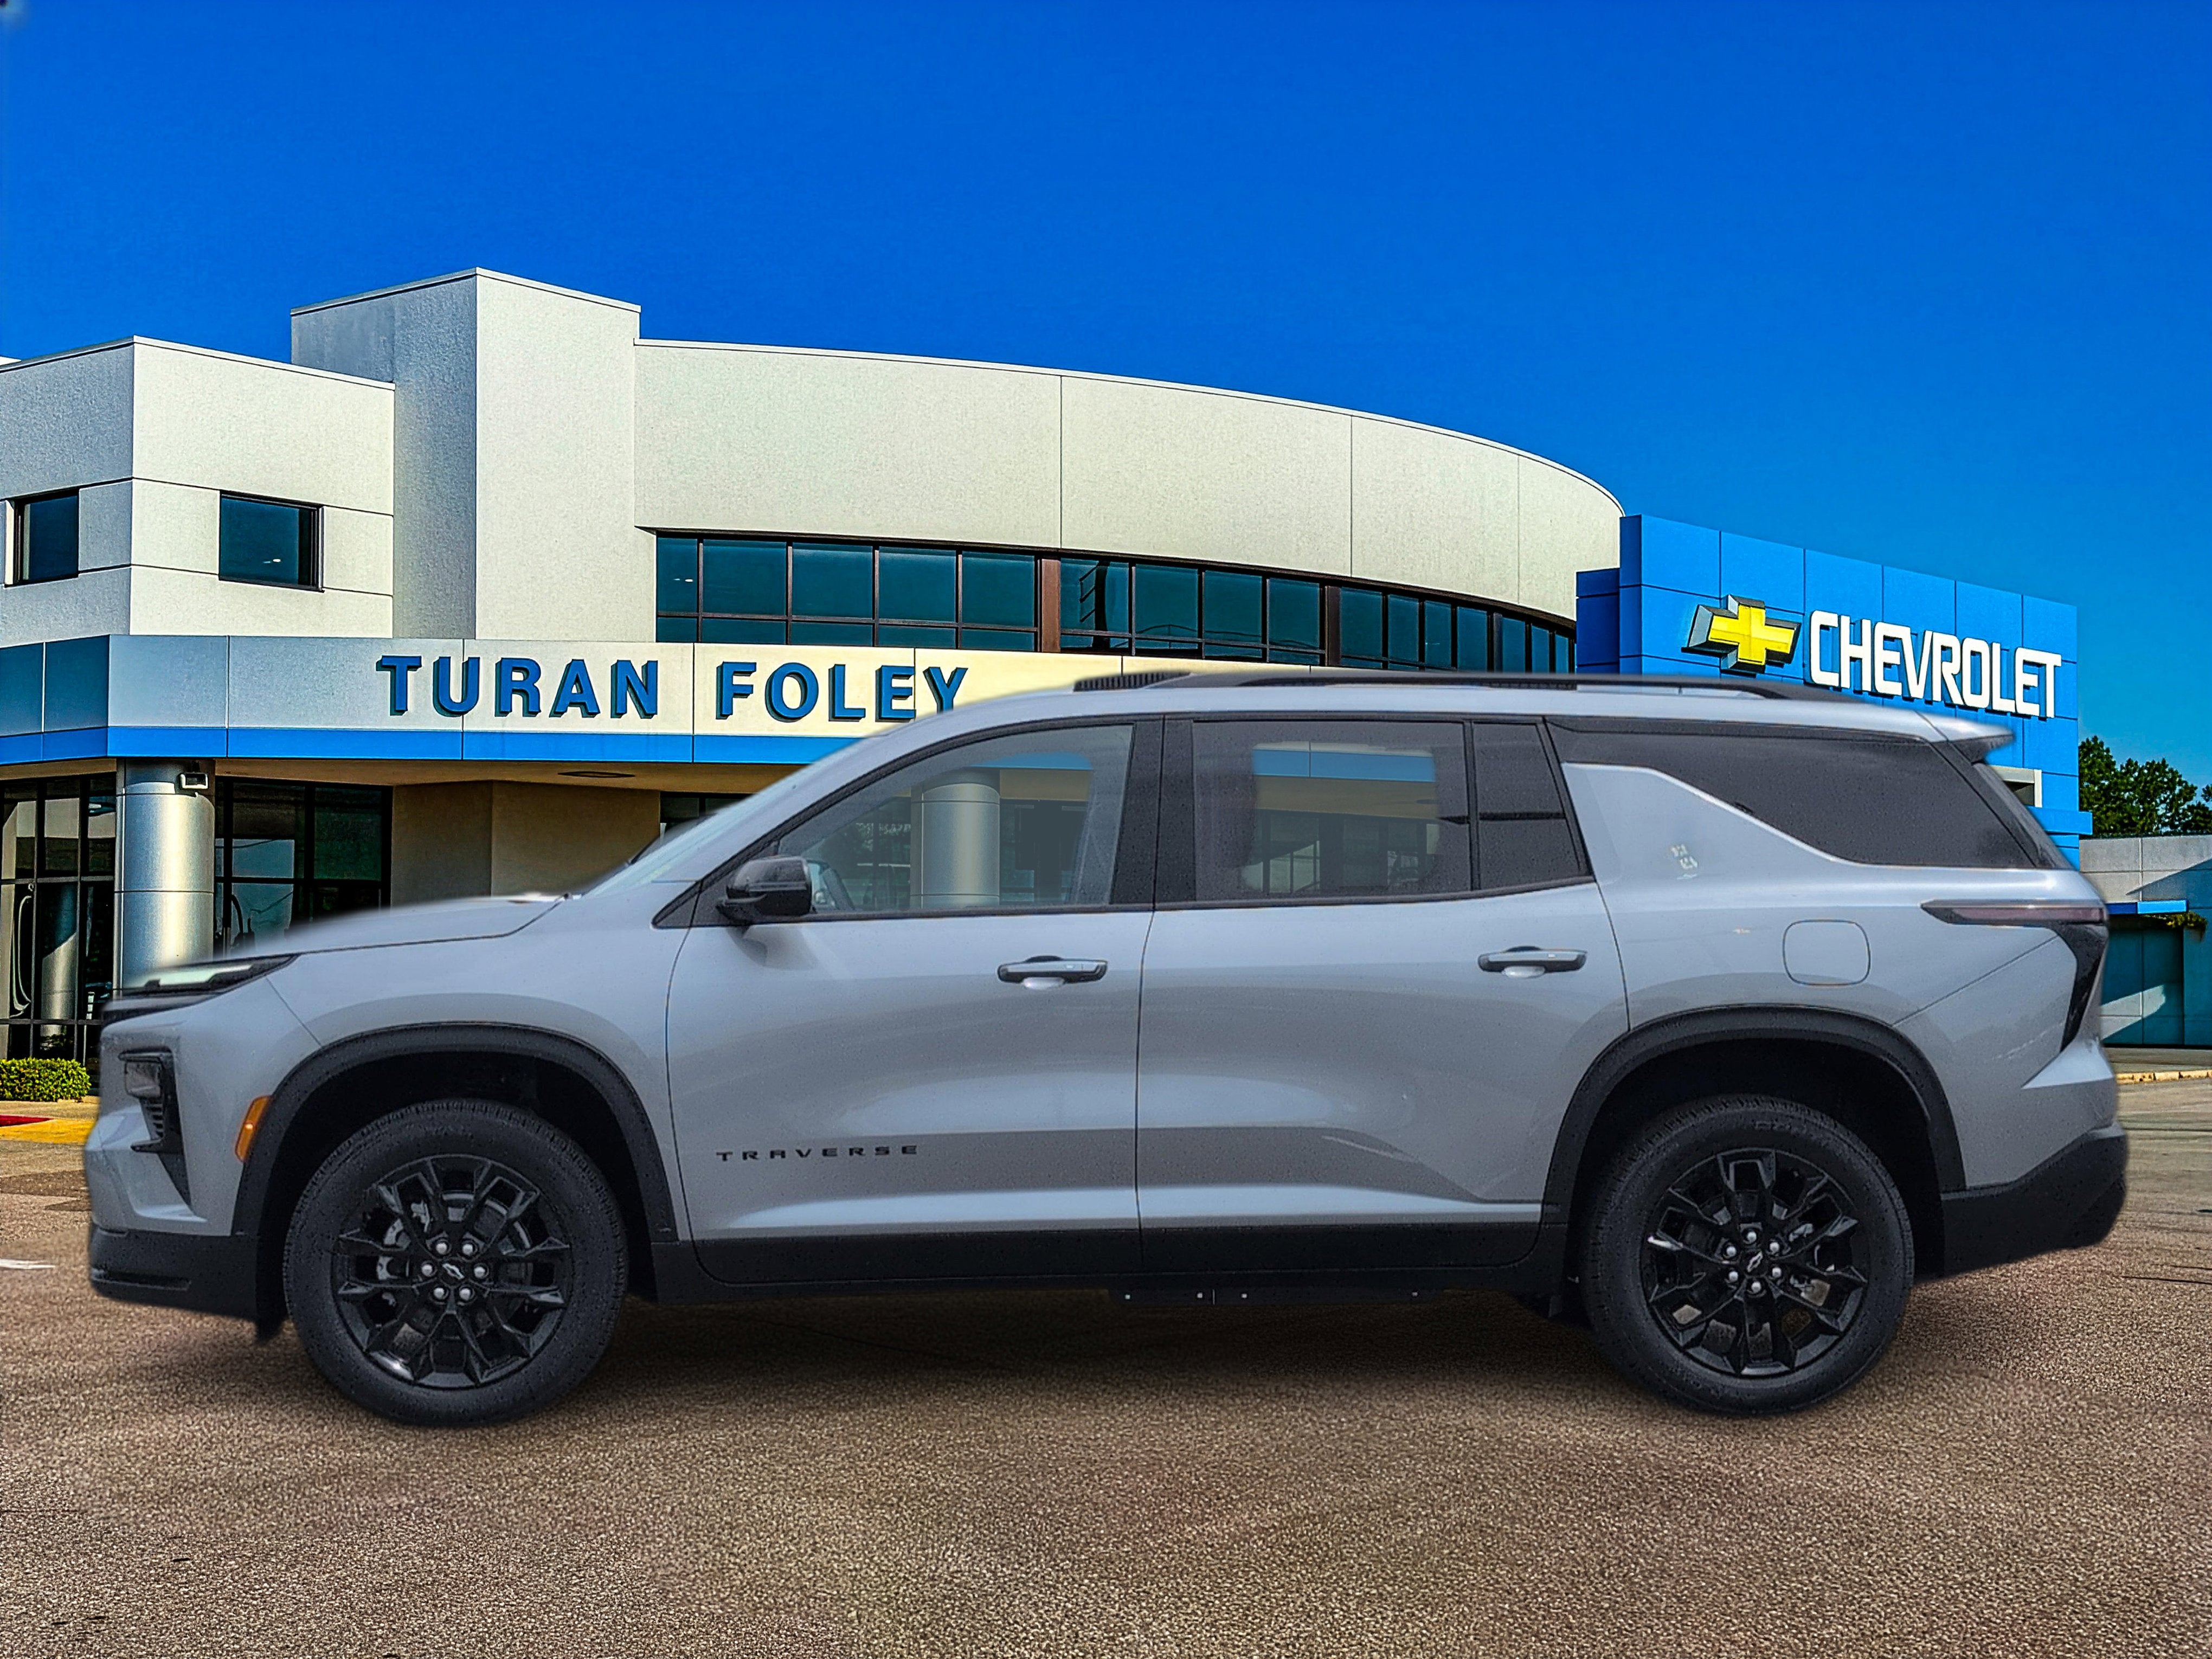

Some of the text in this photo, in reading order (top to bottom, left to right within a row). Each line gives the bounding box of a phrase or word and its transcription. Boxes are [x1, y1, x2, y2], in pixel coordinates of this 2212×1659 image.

[375, 655, 968, 722] TURAN FOLEY
[1810, 609, 2062, 718] CHEVROLET
[716, 1145, 917, 1162] TRAVERSE
